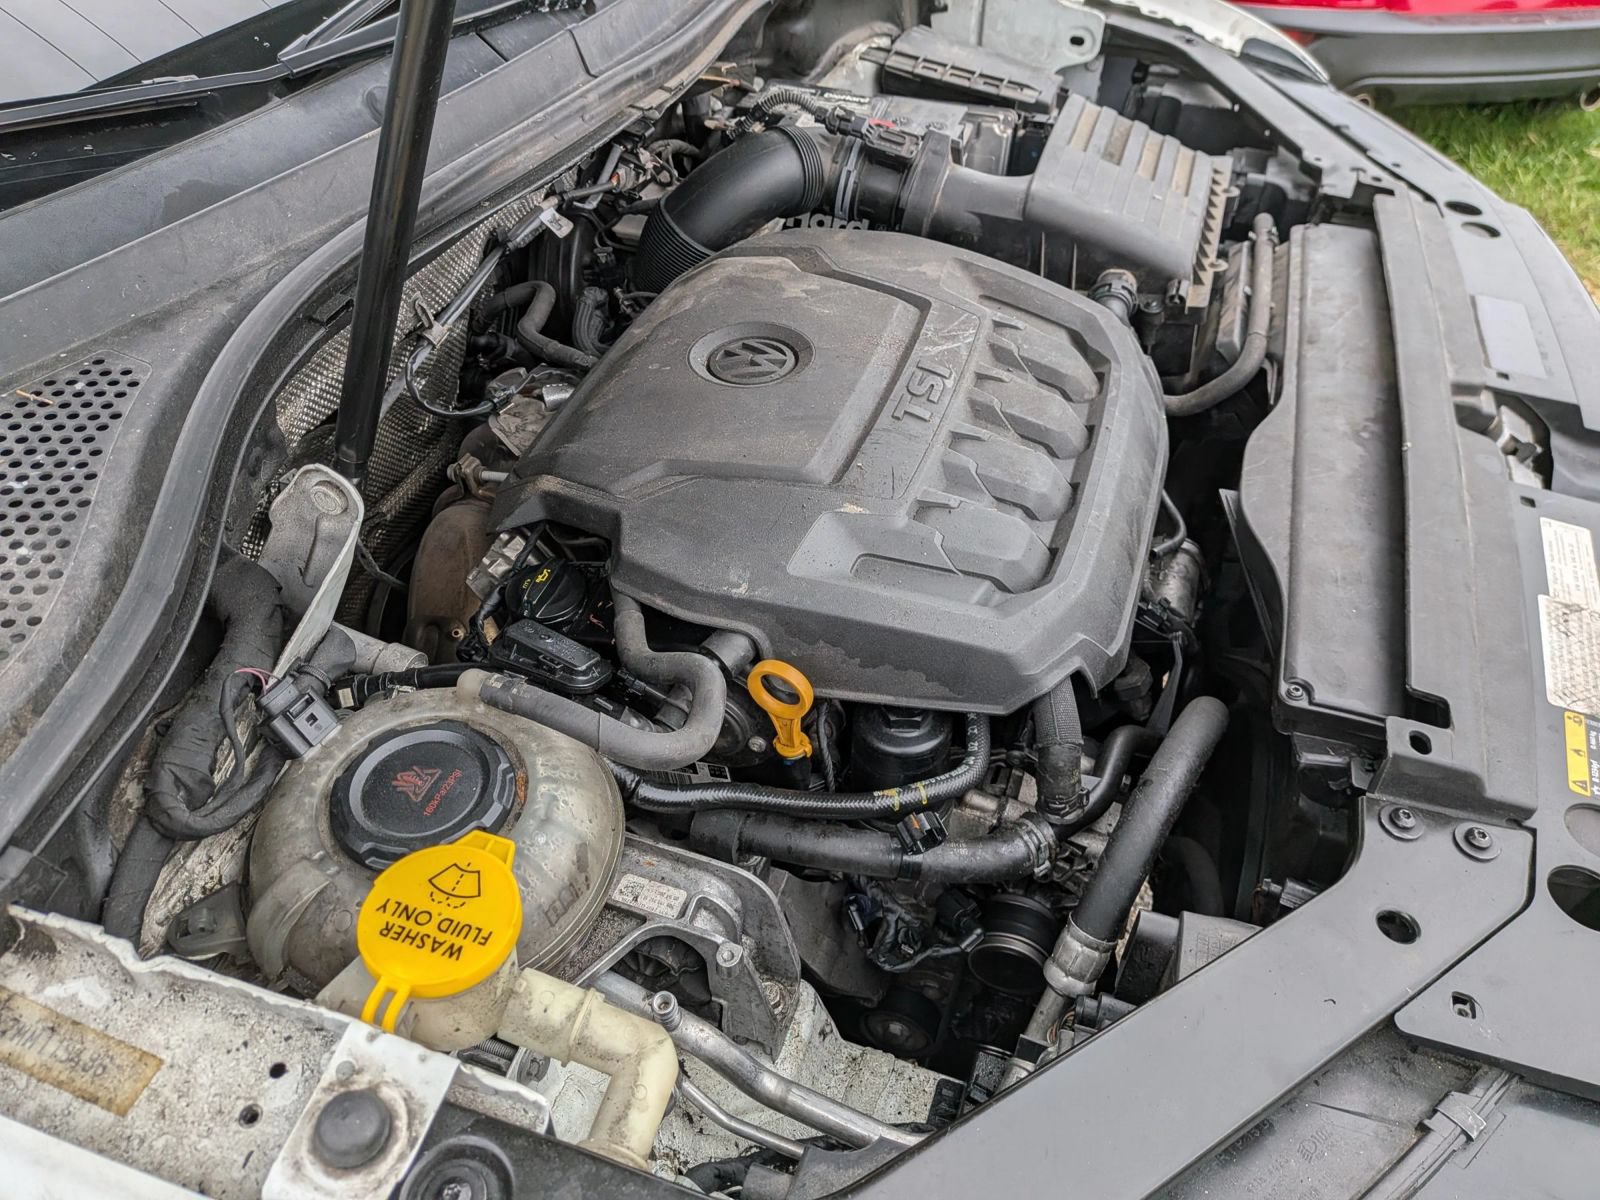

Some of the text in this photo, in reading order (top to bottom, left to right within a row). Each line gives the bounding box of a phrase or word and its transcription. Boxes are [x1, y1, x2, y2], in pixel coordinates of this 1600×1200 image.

[891, 359, 953, 423] TSI
[375, 897, 493, 947] FLUID ONLY
[379, 920, 464, 962] WASHER
